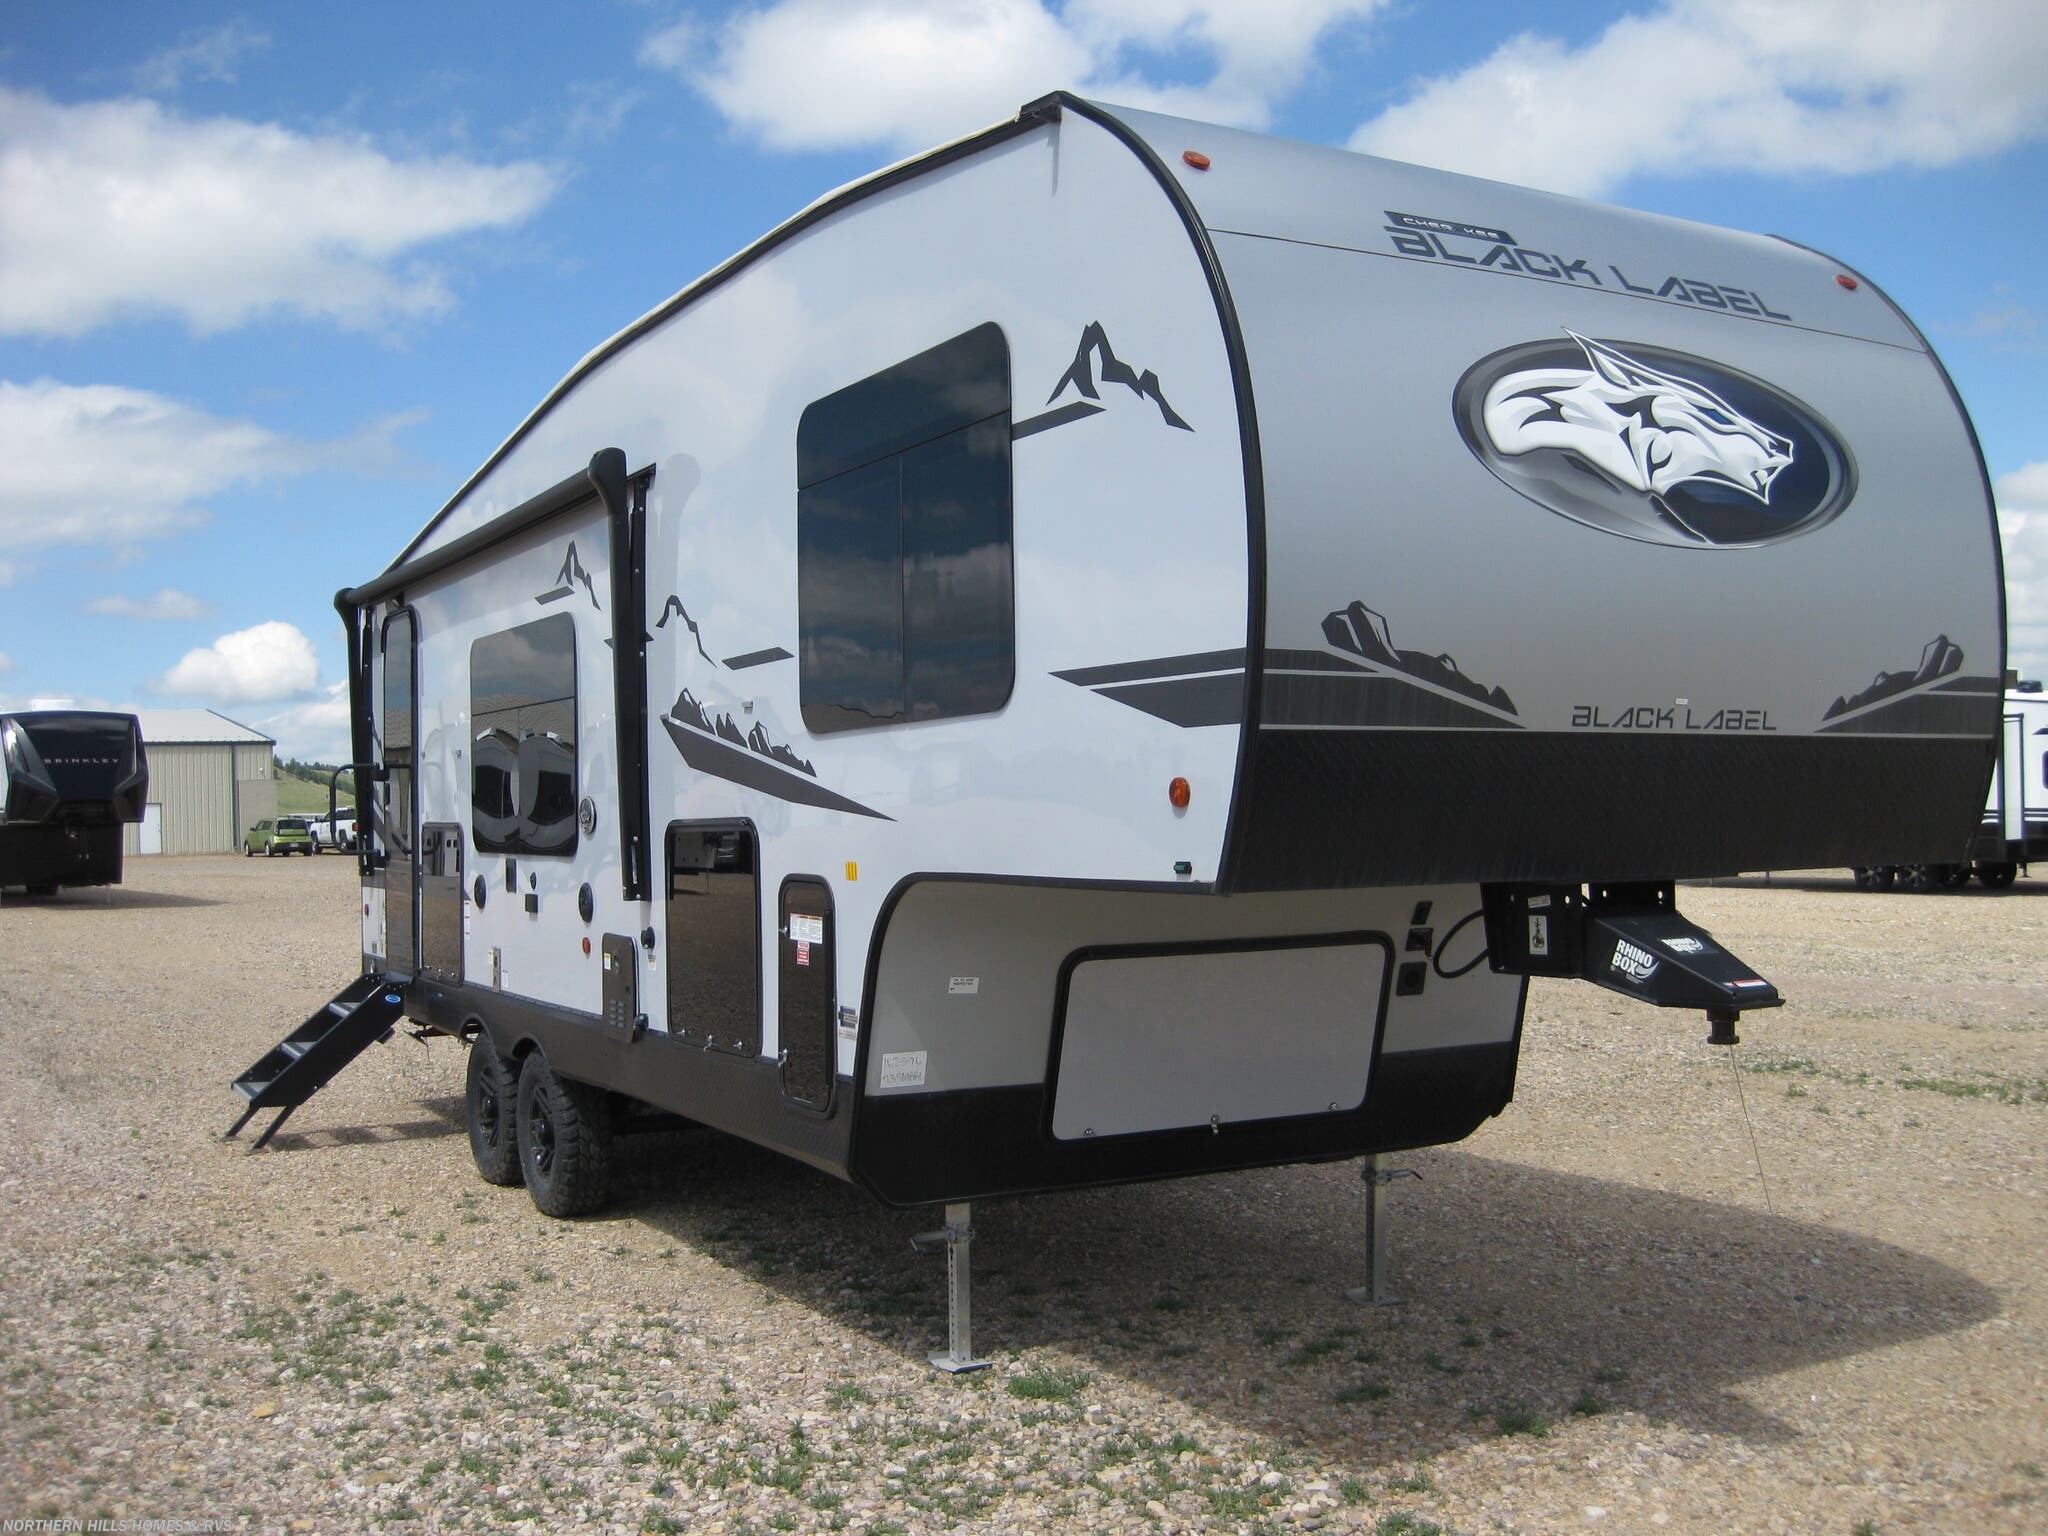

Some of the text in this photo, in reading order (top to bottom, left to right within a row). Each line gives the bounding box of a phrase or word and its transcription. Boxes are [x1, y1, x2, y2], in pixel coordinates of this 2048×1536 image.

[1402, 217, 1500, 240] CHERKEE
[1383, 225, 1792, 321] BLACK LABEL
[1571, 705, 1777, 731] BLACK LABEL
[1611, 951, 1639, 975] BOX
[1616, 939, 1653, 967] RHINO
